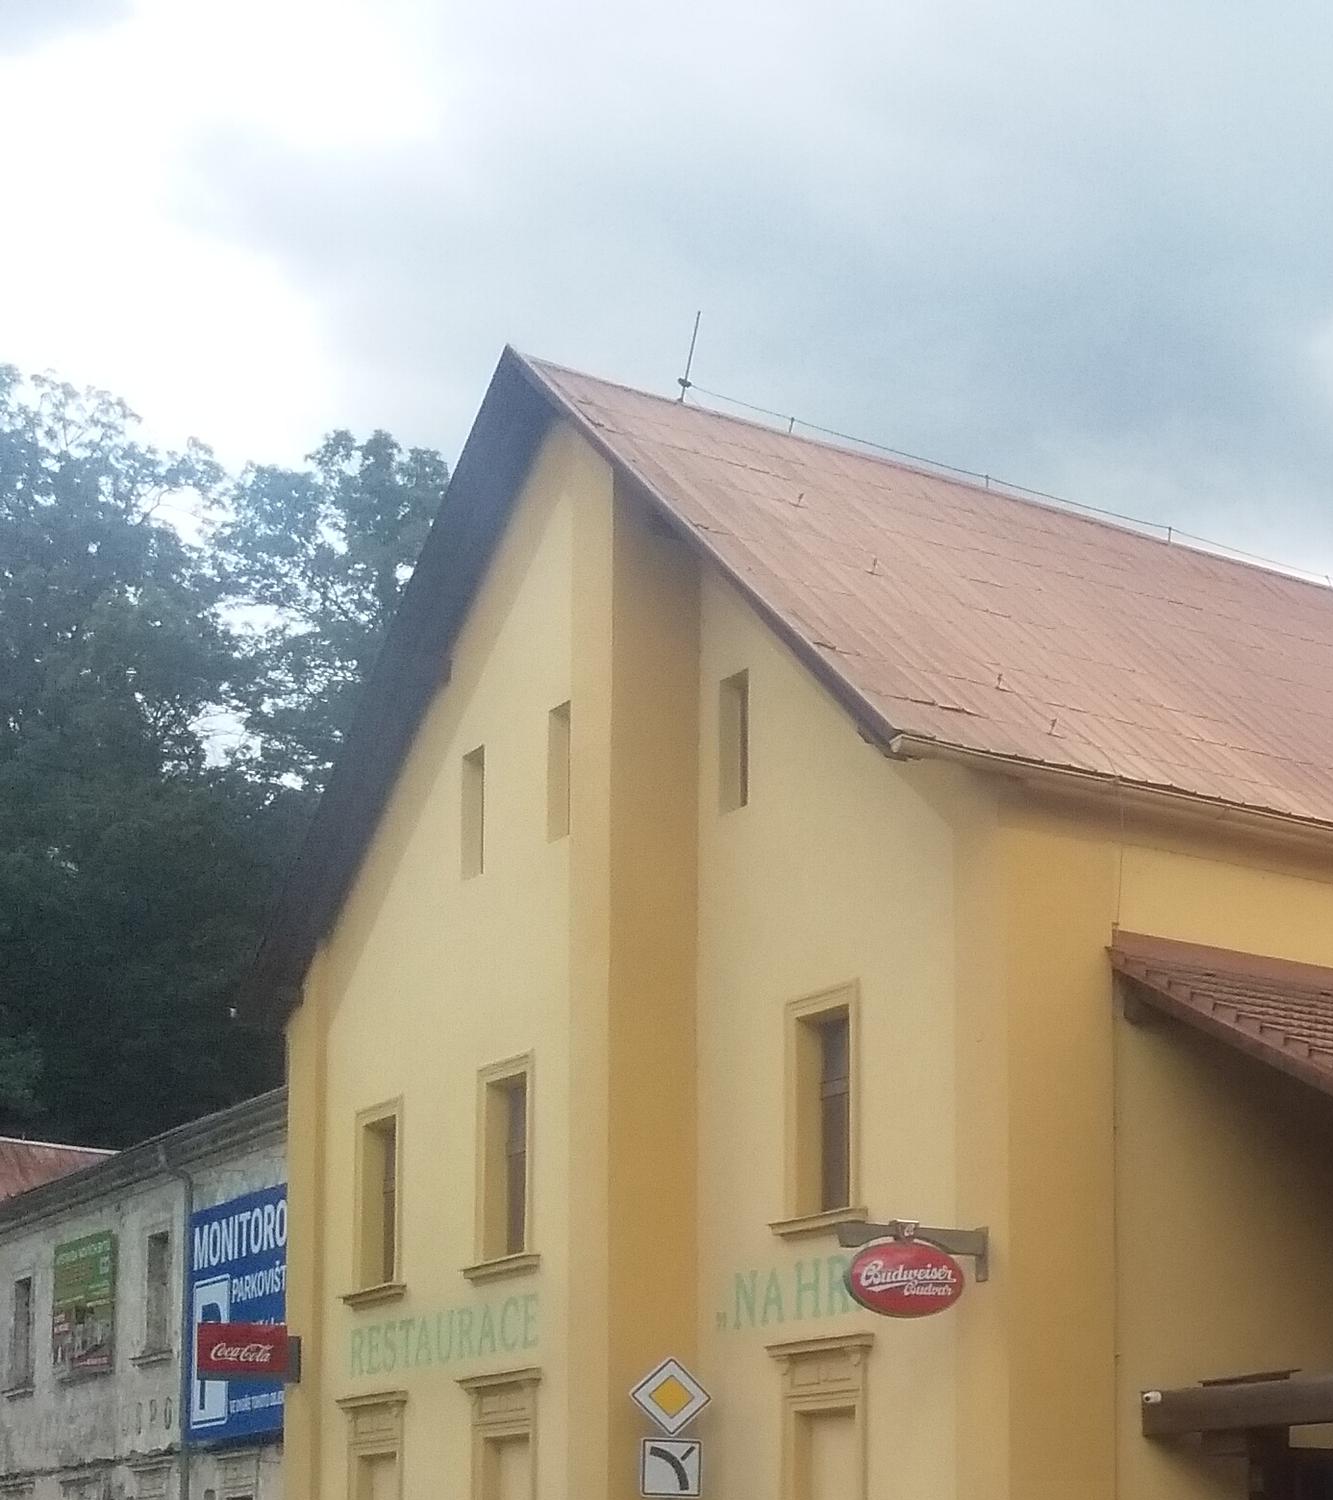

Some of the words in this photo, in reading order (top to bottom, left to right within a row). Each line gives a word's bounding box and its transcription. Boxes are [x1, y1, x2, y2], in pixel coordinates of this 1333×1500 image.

[193, 1199, 287, 1271] MONITORO
[794, 1255, 866, 1321] HR
[860, 1260, 955, 1289] Budweiser
[903, 1281, 952, 1296] Budvar
[351, 1294, 539, 1379] RESTAURACE
